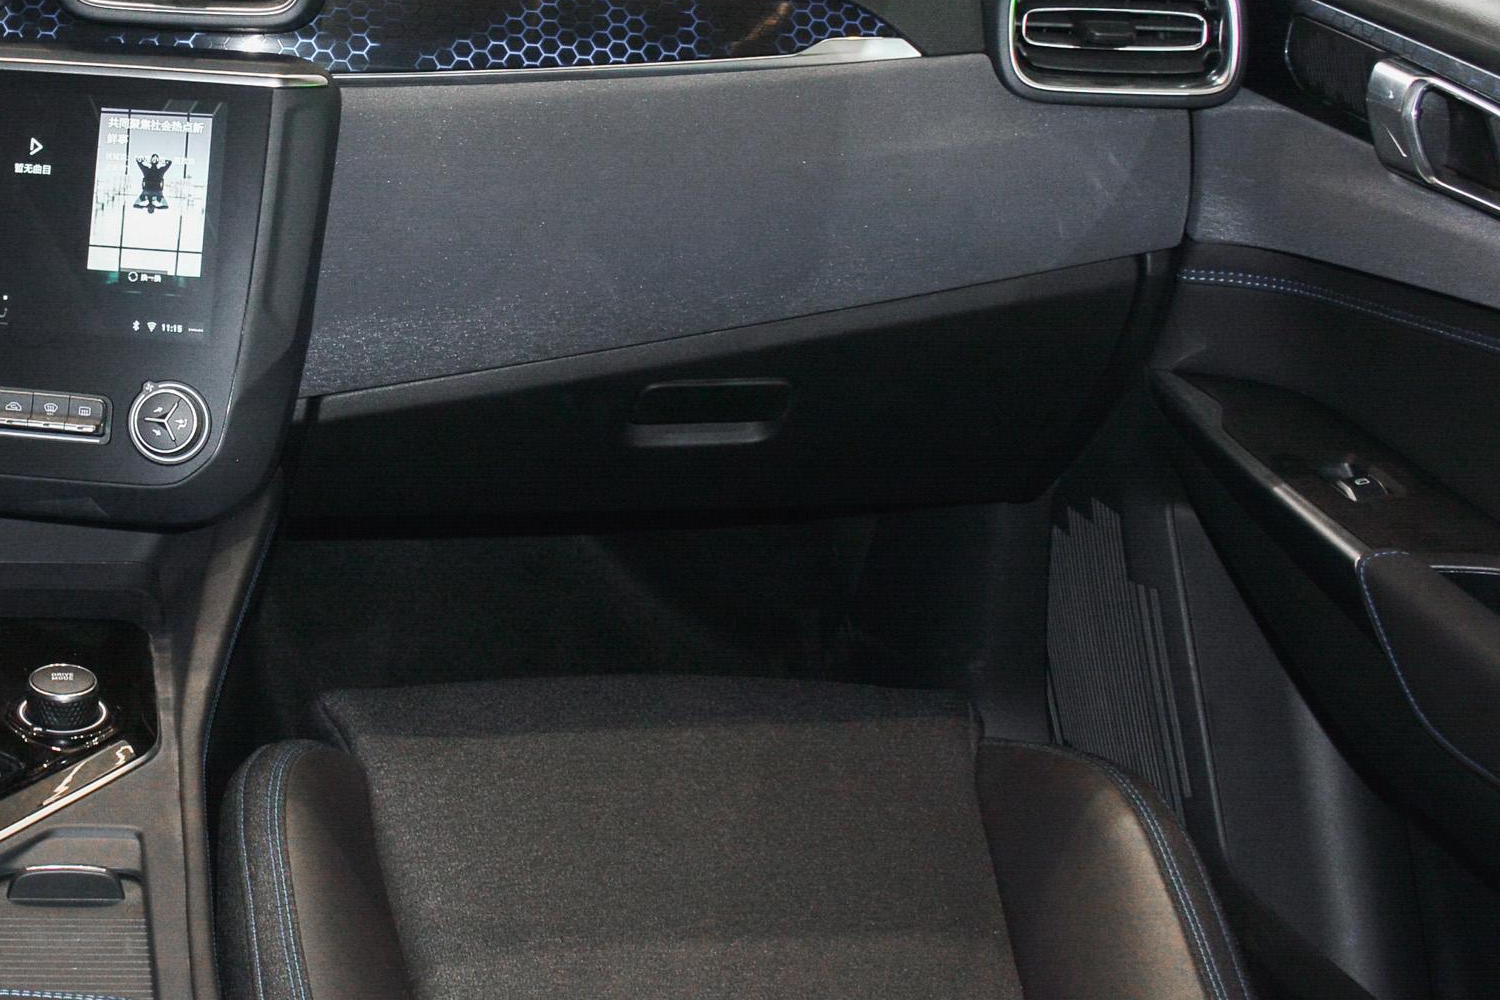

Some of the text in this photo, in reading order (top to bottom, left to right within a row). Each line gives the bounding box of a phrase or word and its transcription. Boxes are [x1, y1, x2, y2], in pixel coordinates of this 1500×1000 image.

[14, 163, 52, 175] 暂无曲目
[161, 323, 183, 333] 11:15
